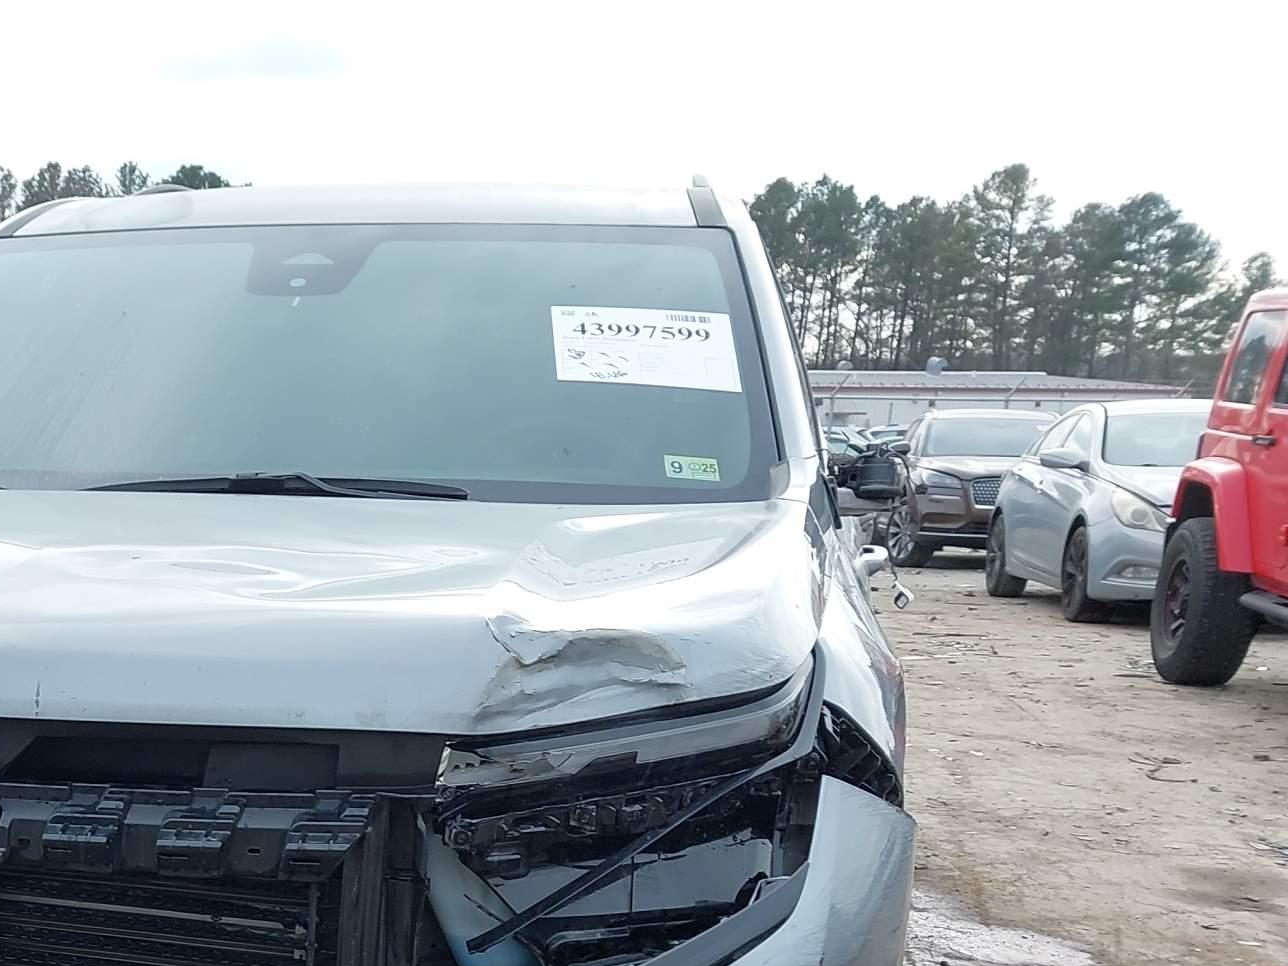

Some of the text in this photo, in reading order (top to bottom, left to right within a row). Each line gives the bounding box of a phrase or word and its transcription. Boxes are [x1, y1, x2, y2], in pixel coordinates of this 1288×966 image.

[572, 322, 711, 342] 43997599
[670, 460, 717, 474] 9 25
